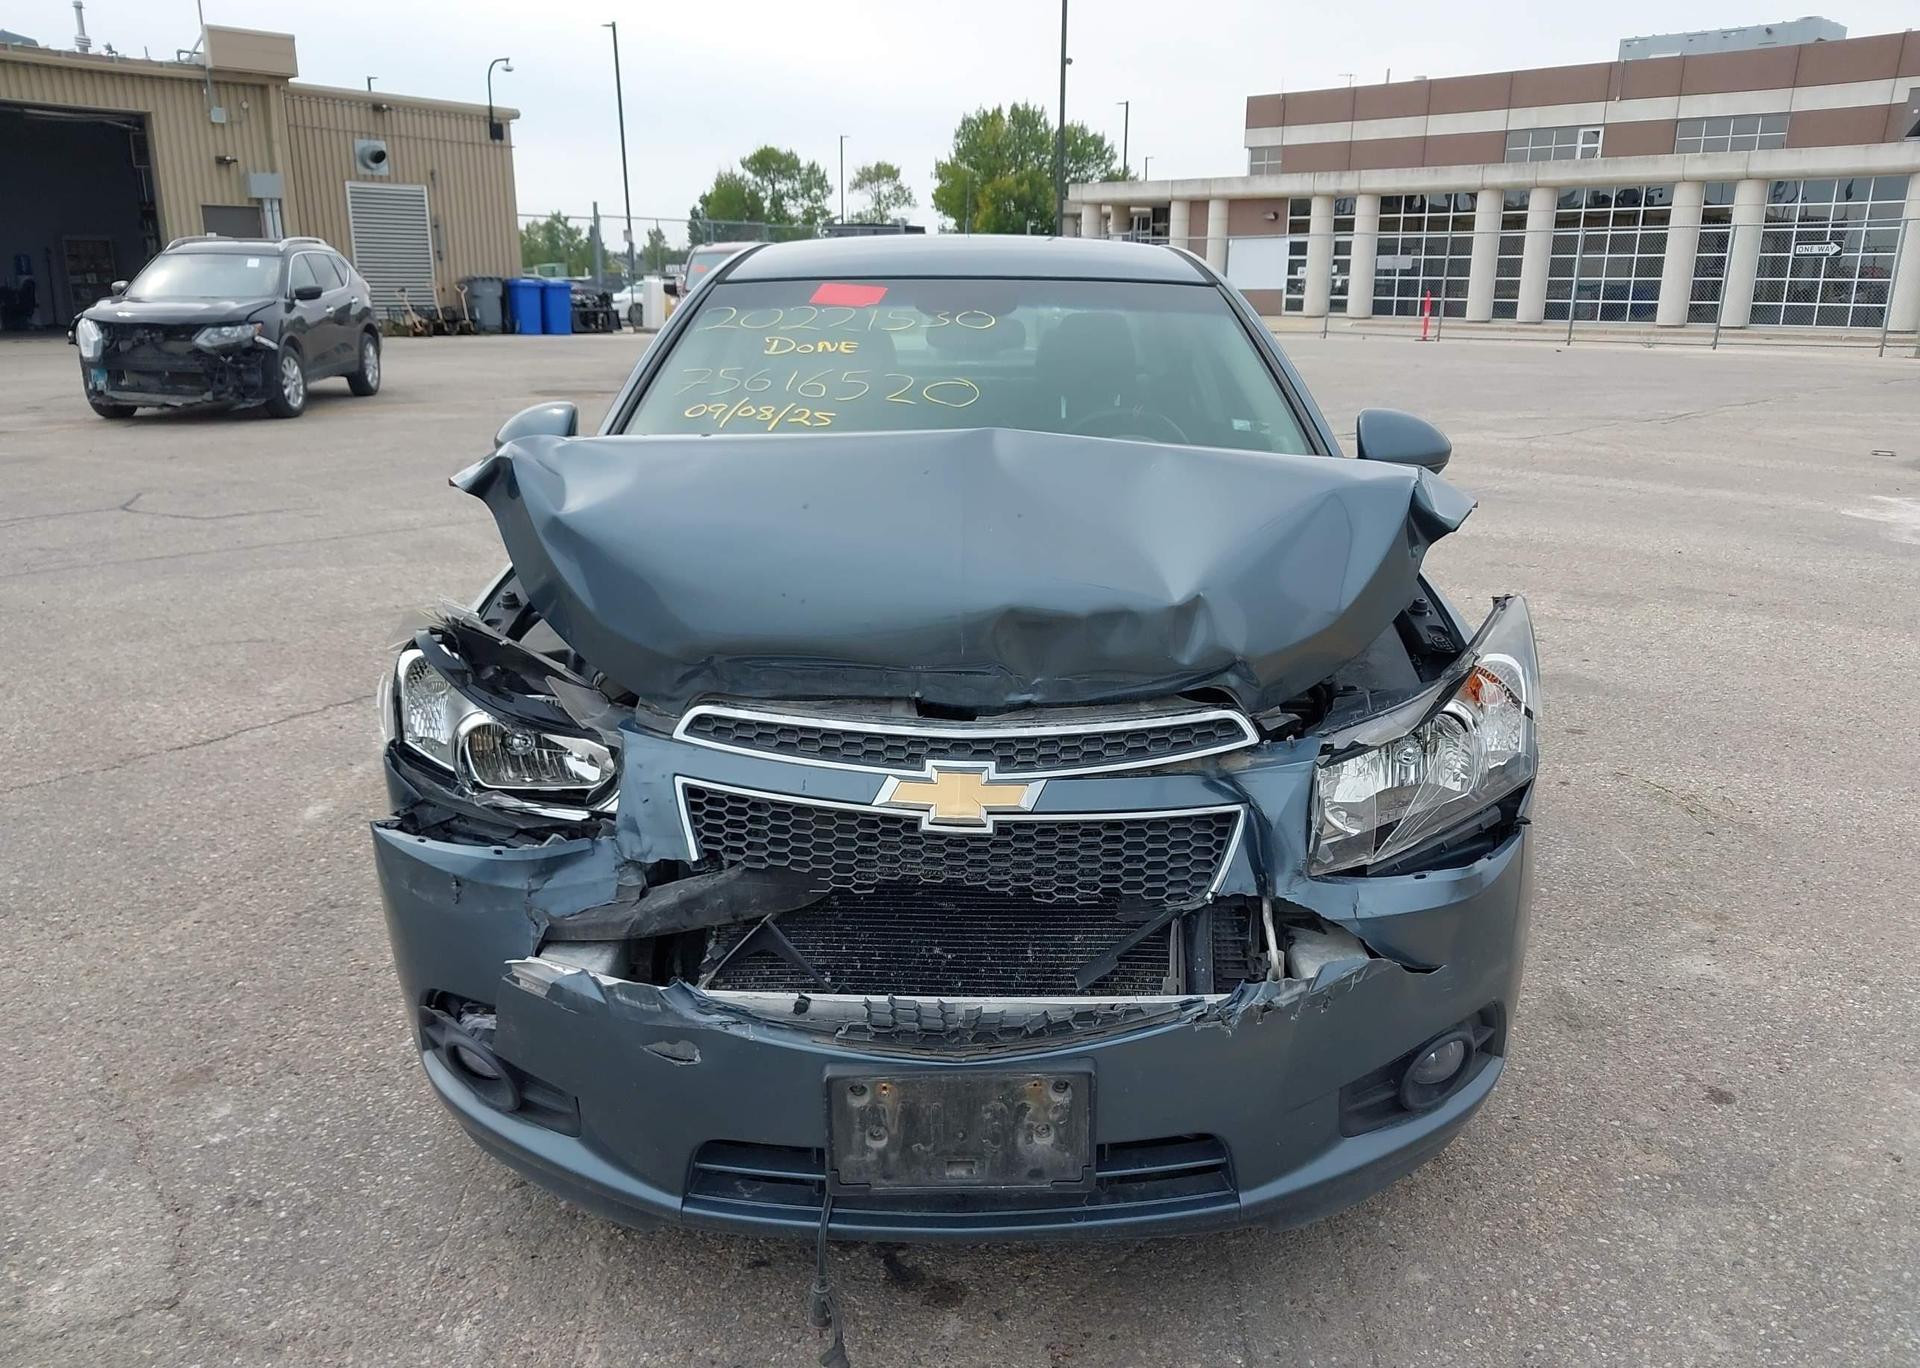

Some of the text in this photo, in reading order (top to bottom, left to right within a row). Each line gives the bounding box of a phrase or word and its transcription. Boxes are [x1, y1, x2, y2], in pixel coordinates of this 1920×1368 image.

[1818, 245, 1836, 253] WAY
[674, 367, 980, 407] 75616520
[684, 397, 837, 431] 09/08/25
